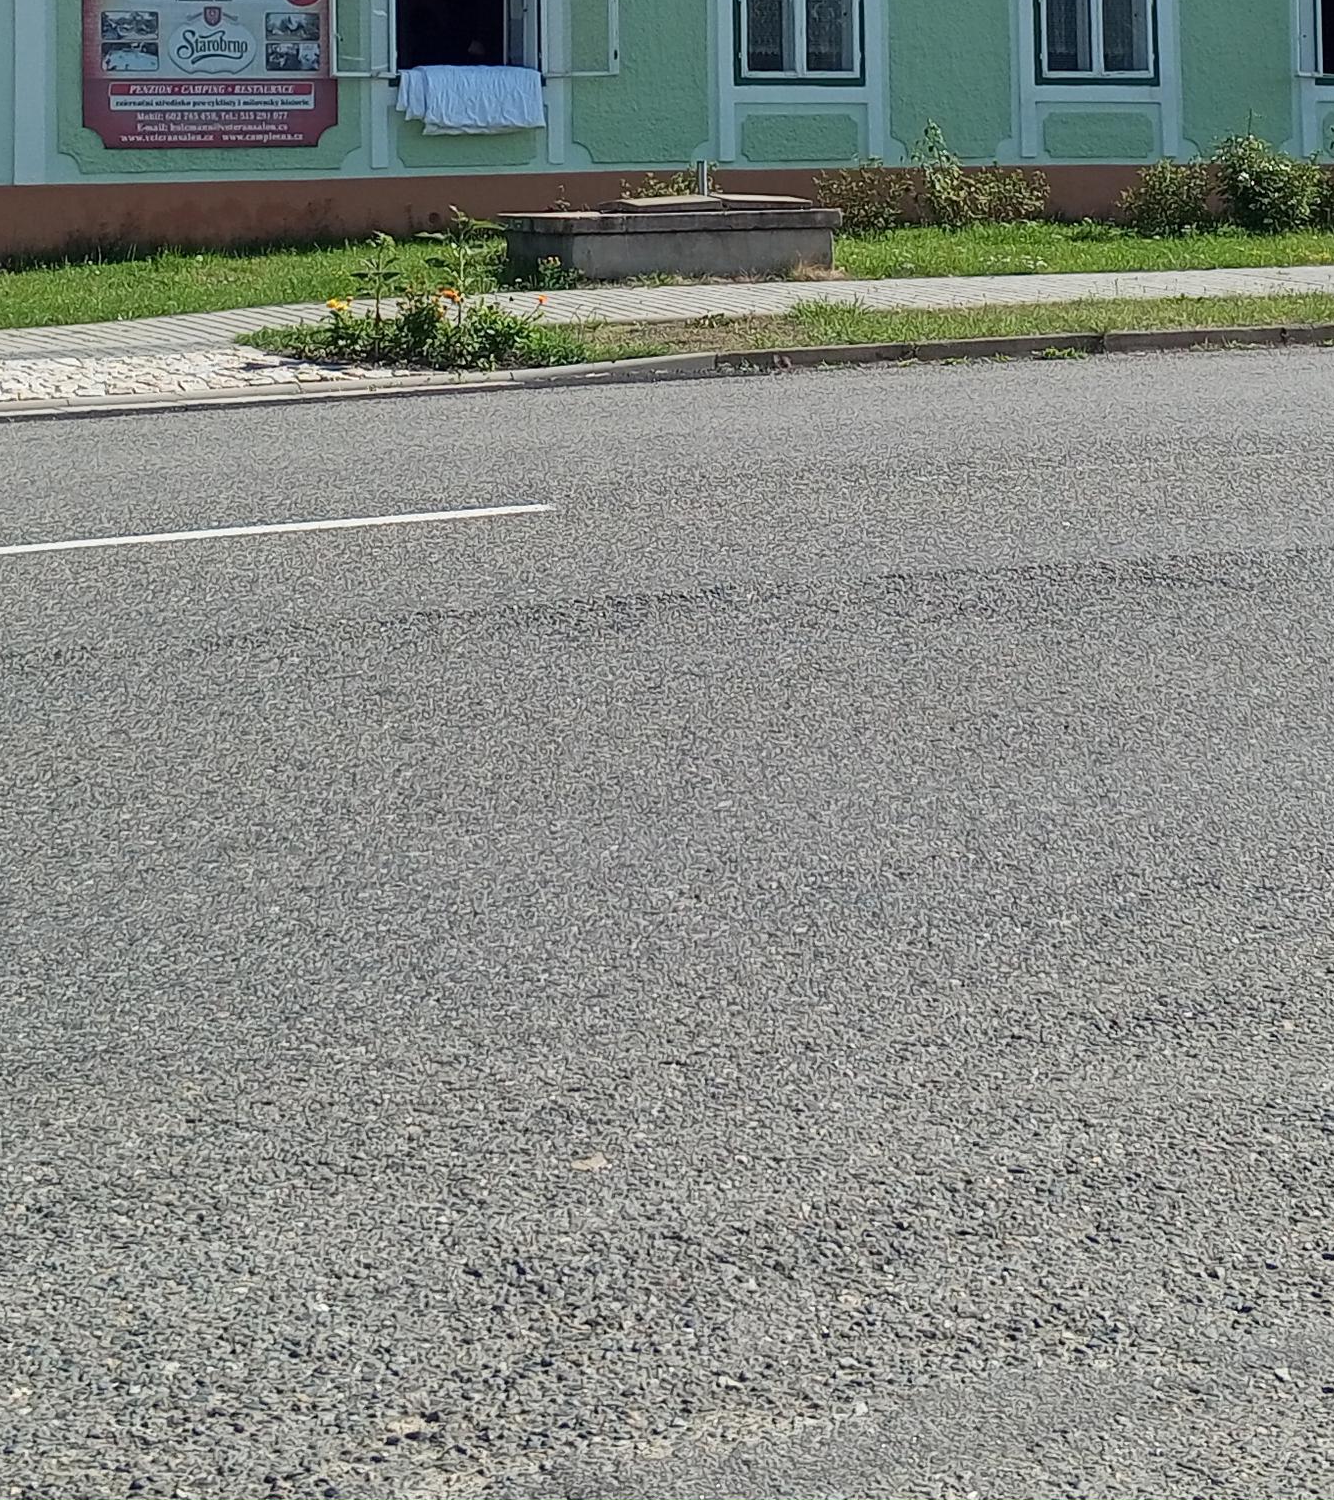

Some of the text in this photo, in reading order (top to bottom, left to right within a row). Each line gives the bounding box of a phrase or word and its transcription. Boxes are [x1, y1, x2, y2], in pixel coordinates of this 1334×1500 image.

[176, 29, 249, 65] Starobrno
[129, 84, 295, 94] PENZION CAMPING RESTAURACE
